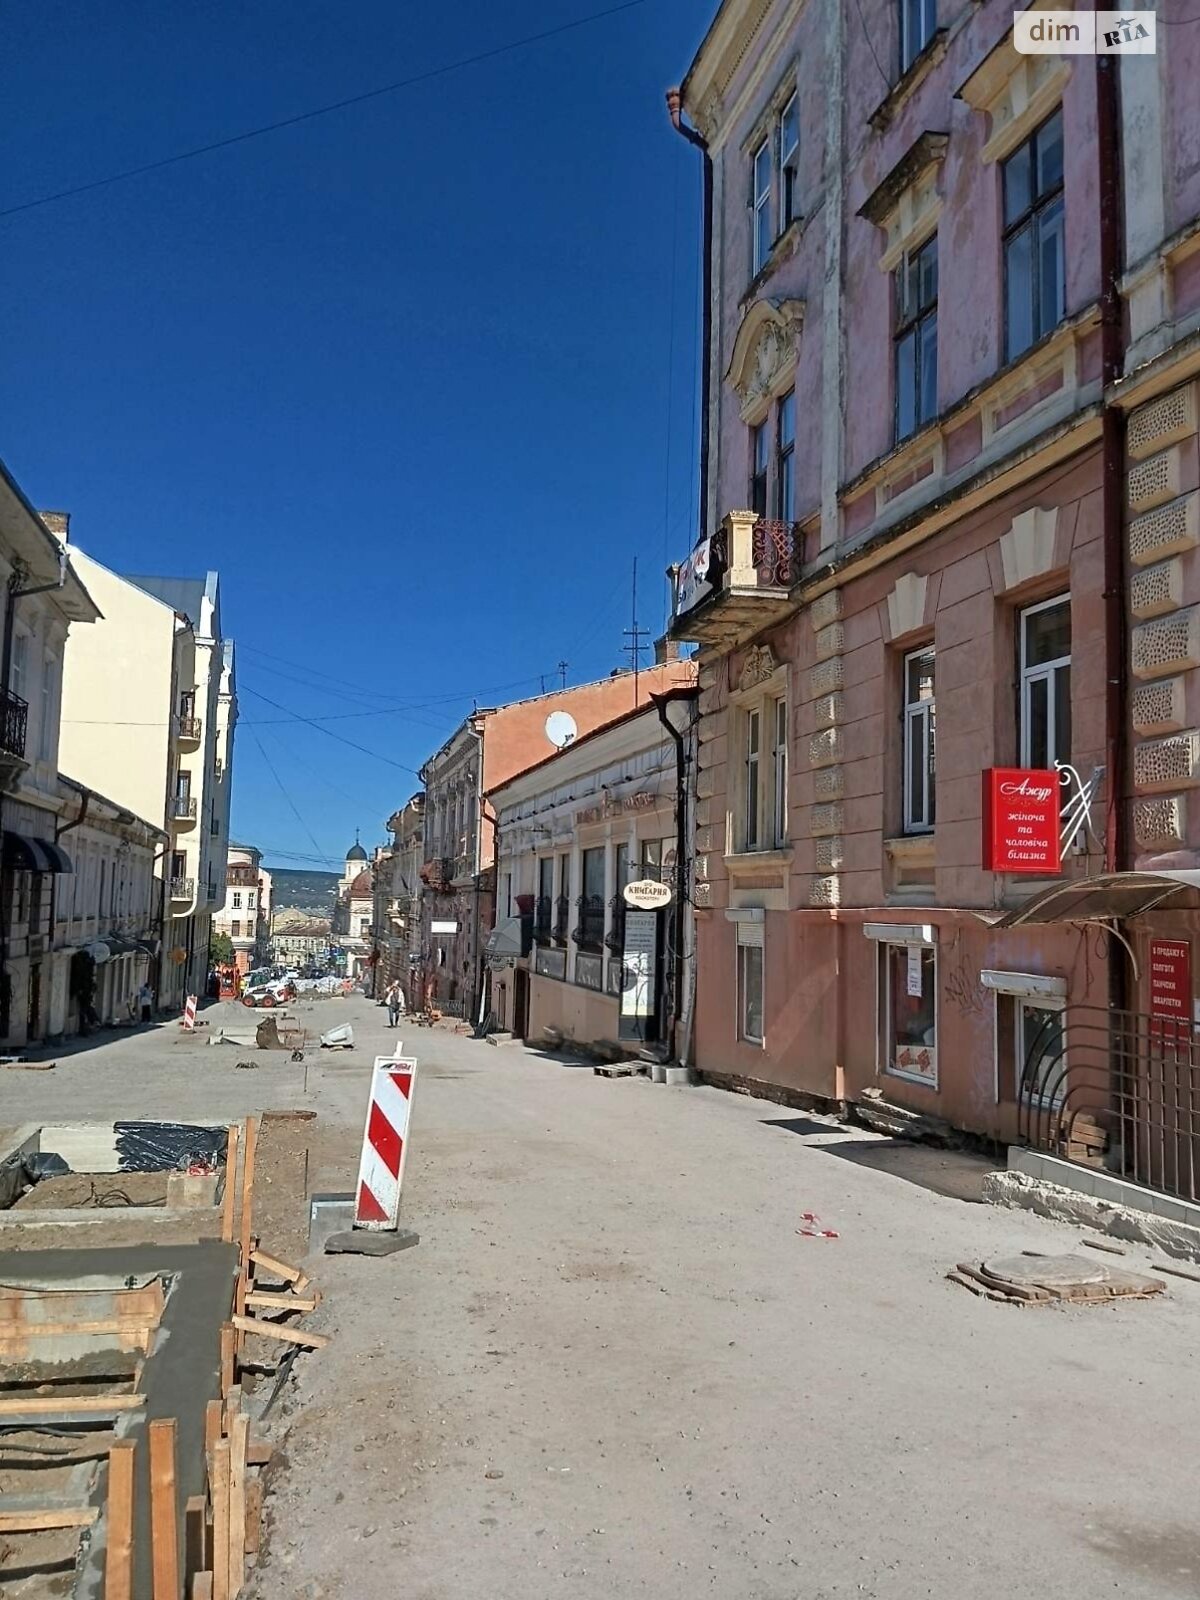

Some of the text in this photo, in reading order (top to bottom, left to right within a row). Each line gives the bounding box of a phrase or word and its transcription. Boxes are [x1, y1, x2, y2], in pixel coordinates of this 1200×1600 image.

[1000, 778, 1052, 800] Ажур
[1007, 811, 1045, 822] жіноча
[1017, 826, 1033, 834] та
[1007, 849, 1046, 860] білизна
[628, 886, 668, 896] КНИГАРНЯ
[1157, 947, 1180, 957] ПРОДАЖУ
[1153, 996, 1181, 1007] ШКАРПЕТКИ
